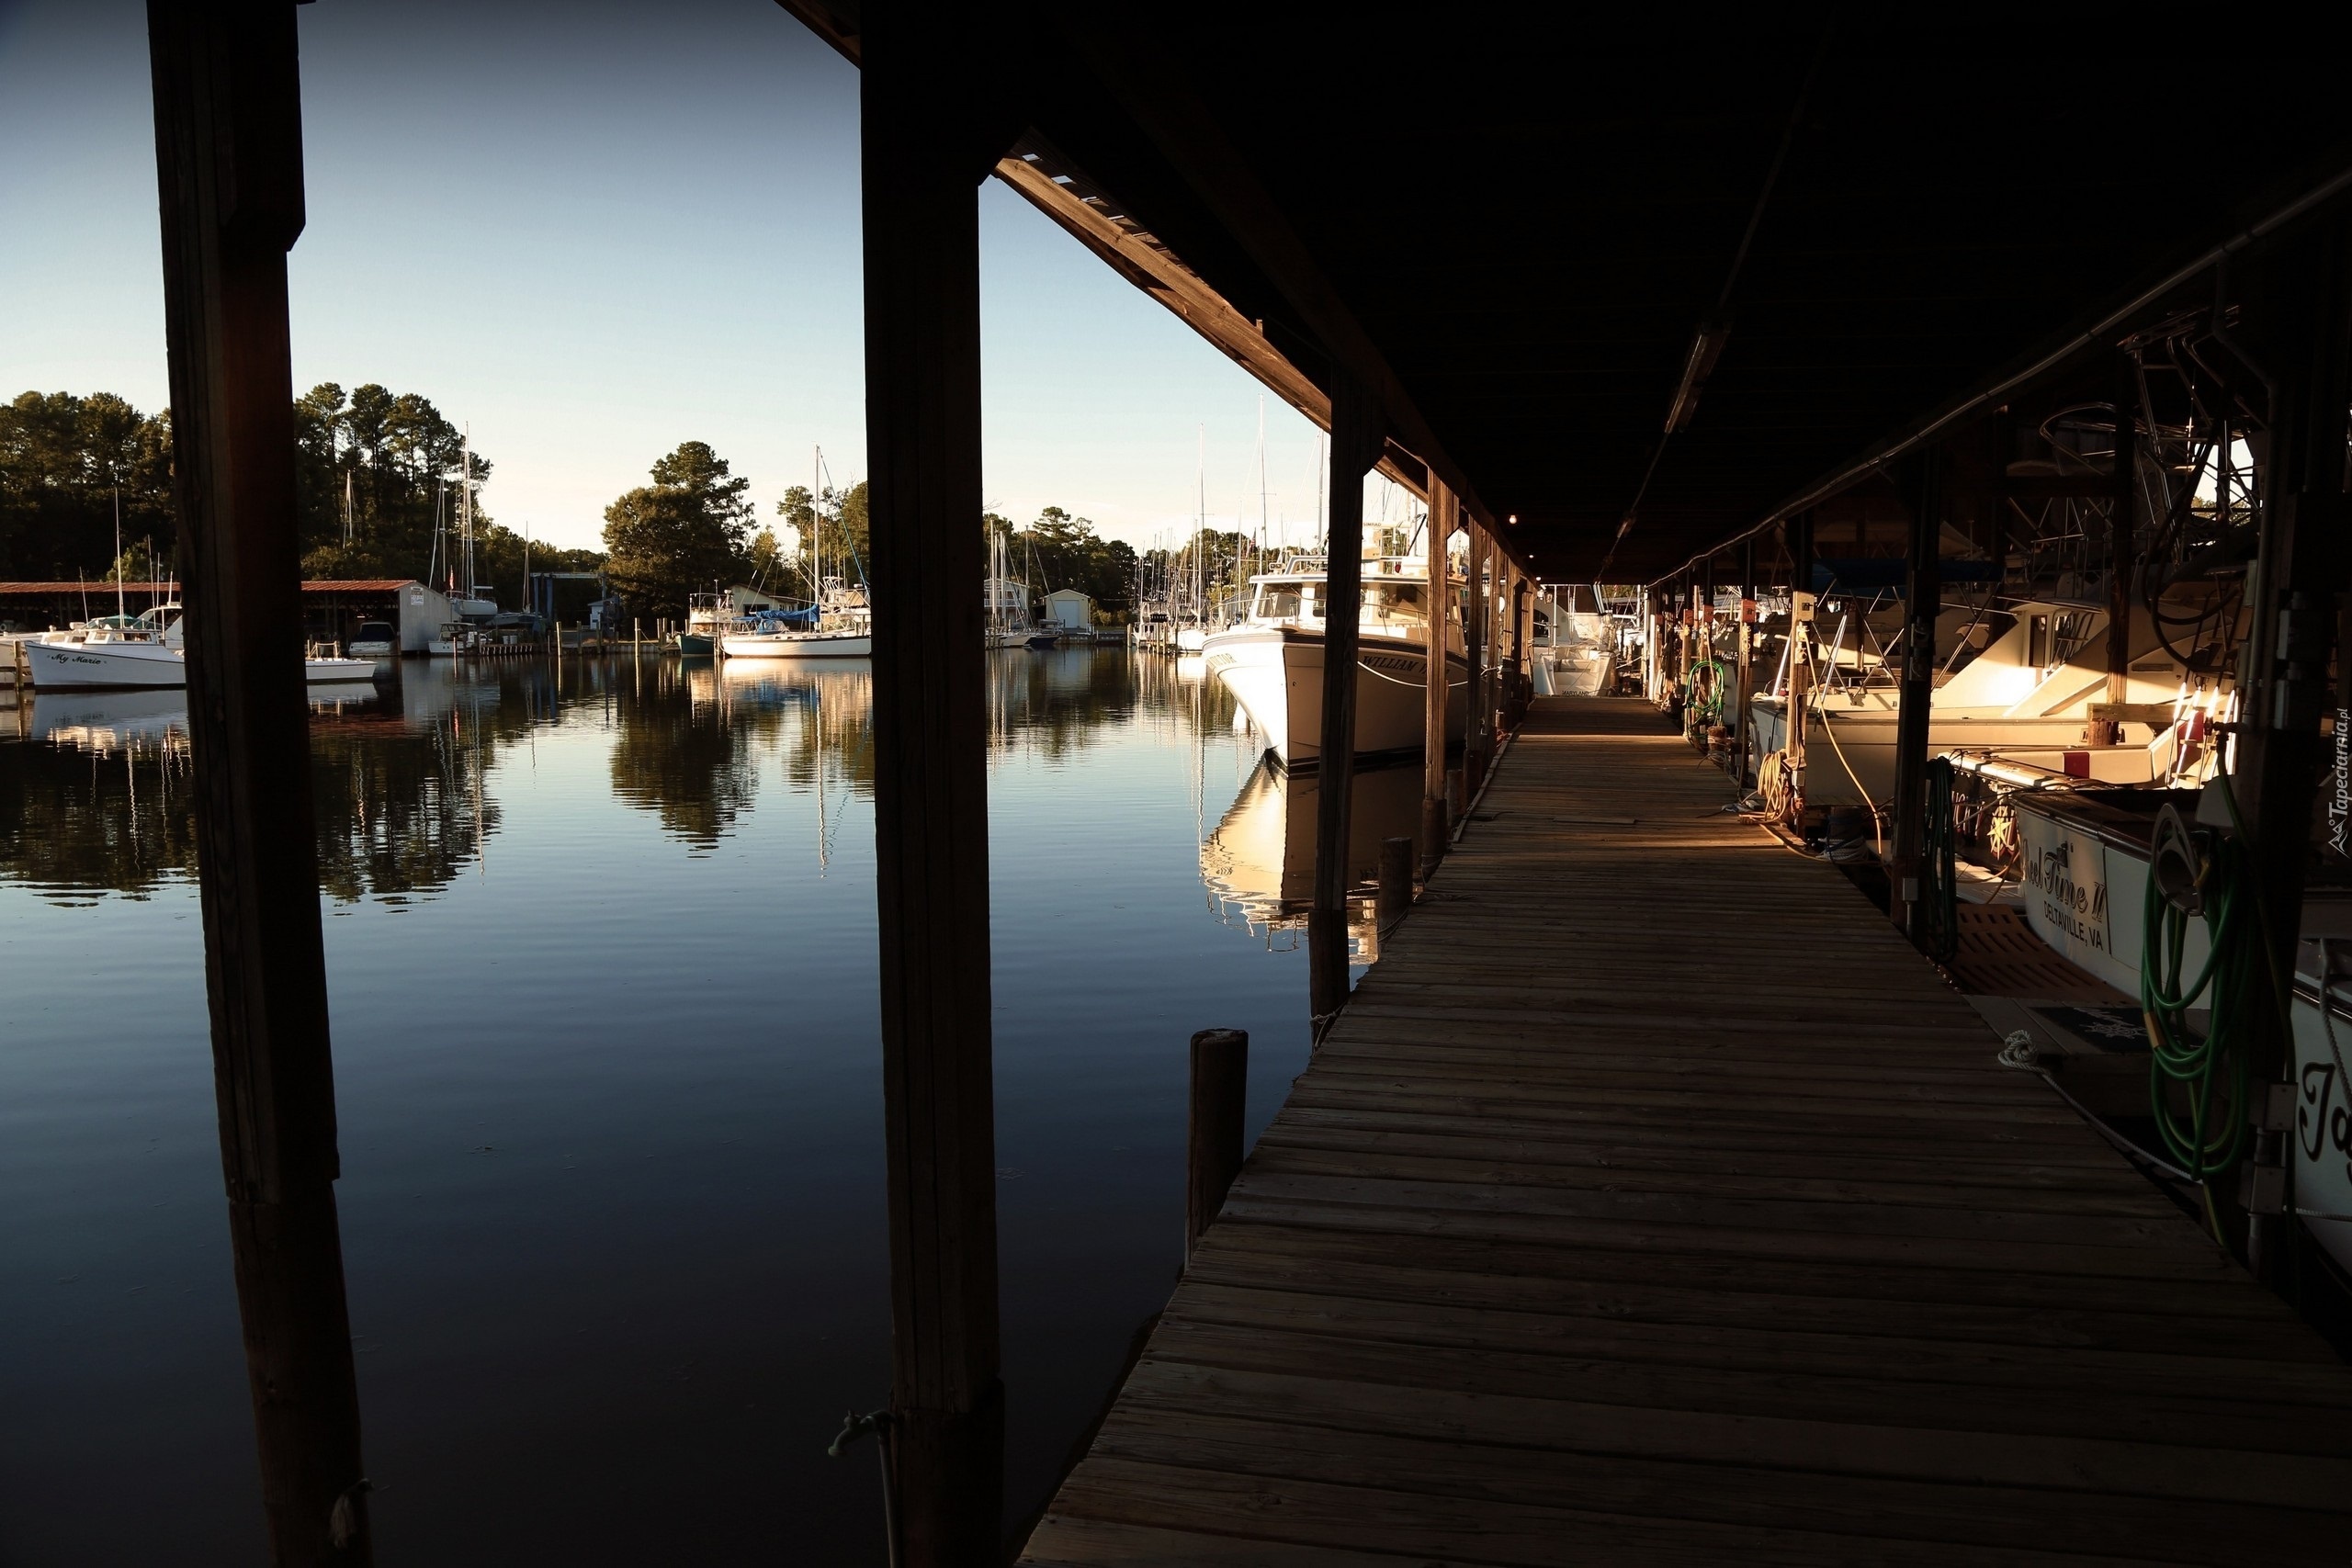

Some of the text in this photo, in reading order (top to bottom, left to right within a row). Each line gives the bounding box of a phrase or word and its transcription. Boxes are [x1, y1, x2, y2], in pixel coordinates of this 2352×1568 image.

[51, 653, 102, 665] My Marie
[1363, 655, 1419, 672] WILLIAM
[2044, 851, 2088, 914] Time
[2043, 900, 2104, 952] DELTAVILLE, VA
